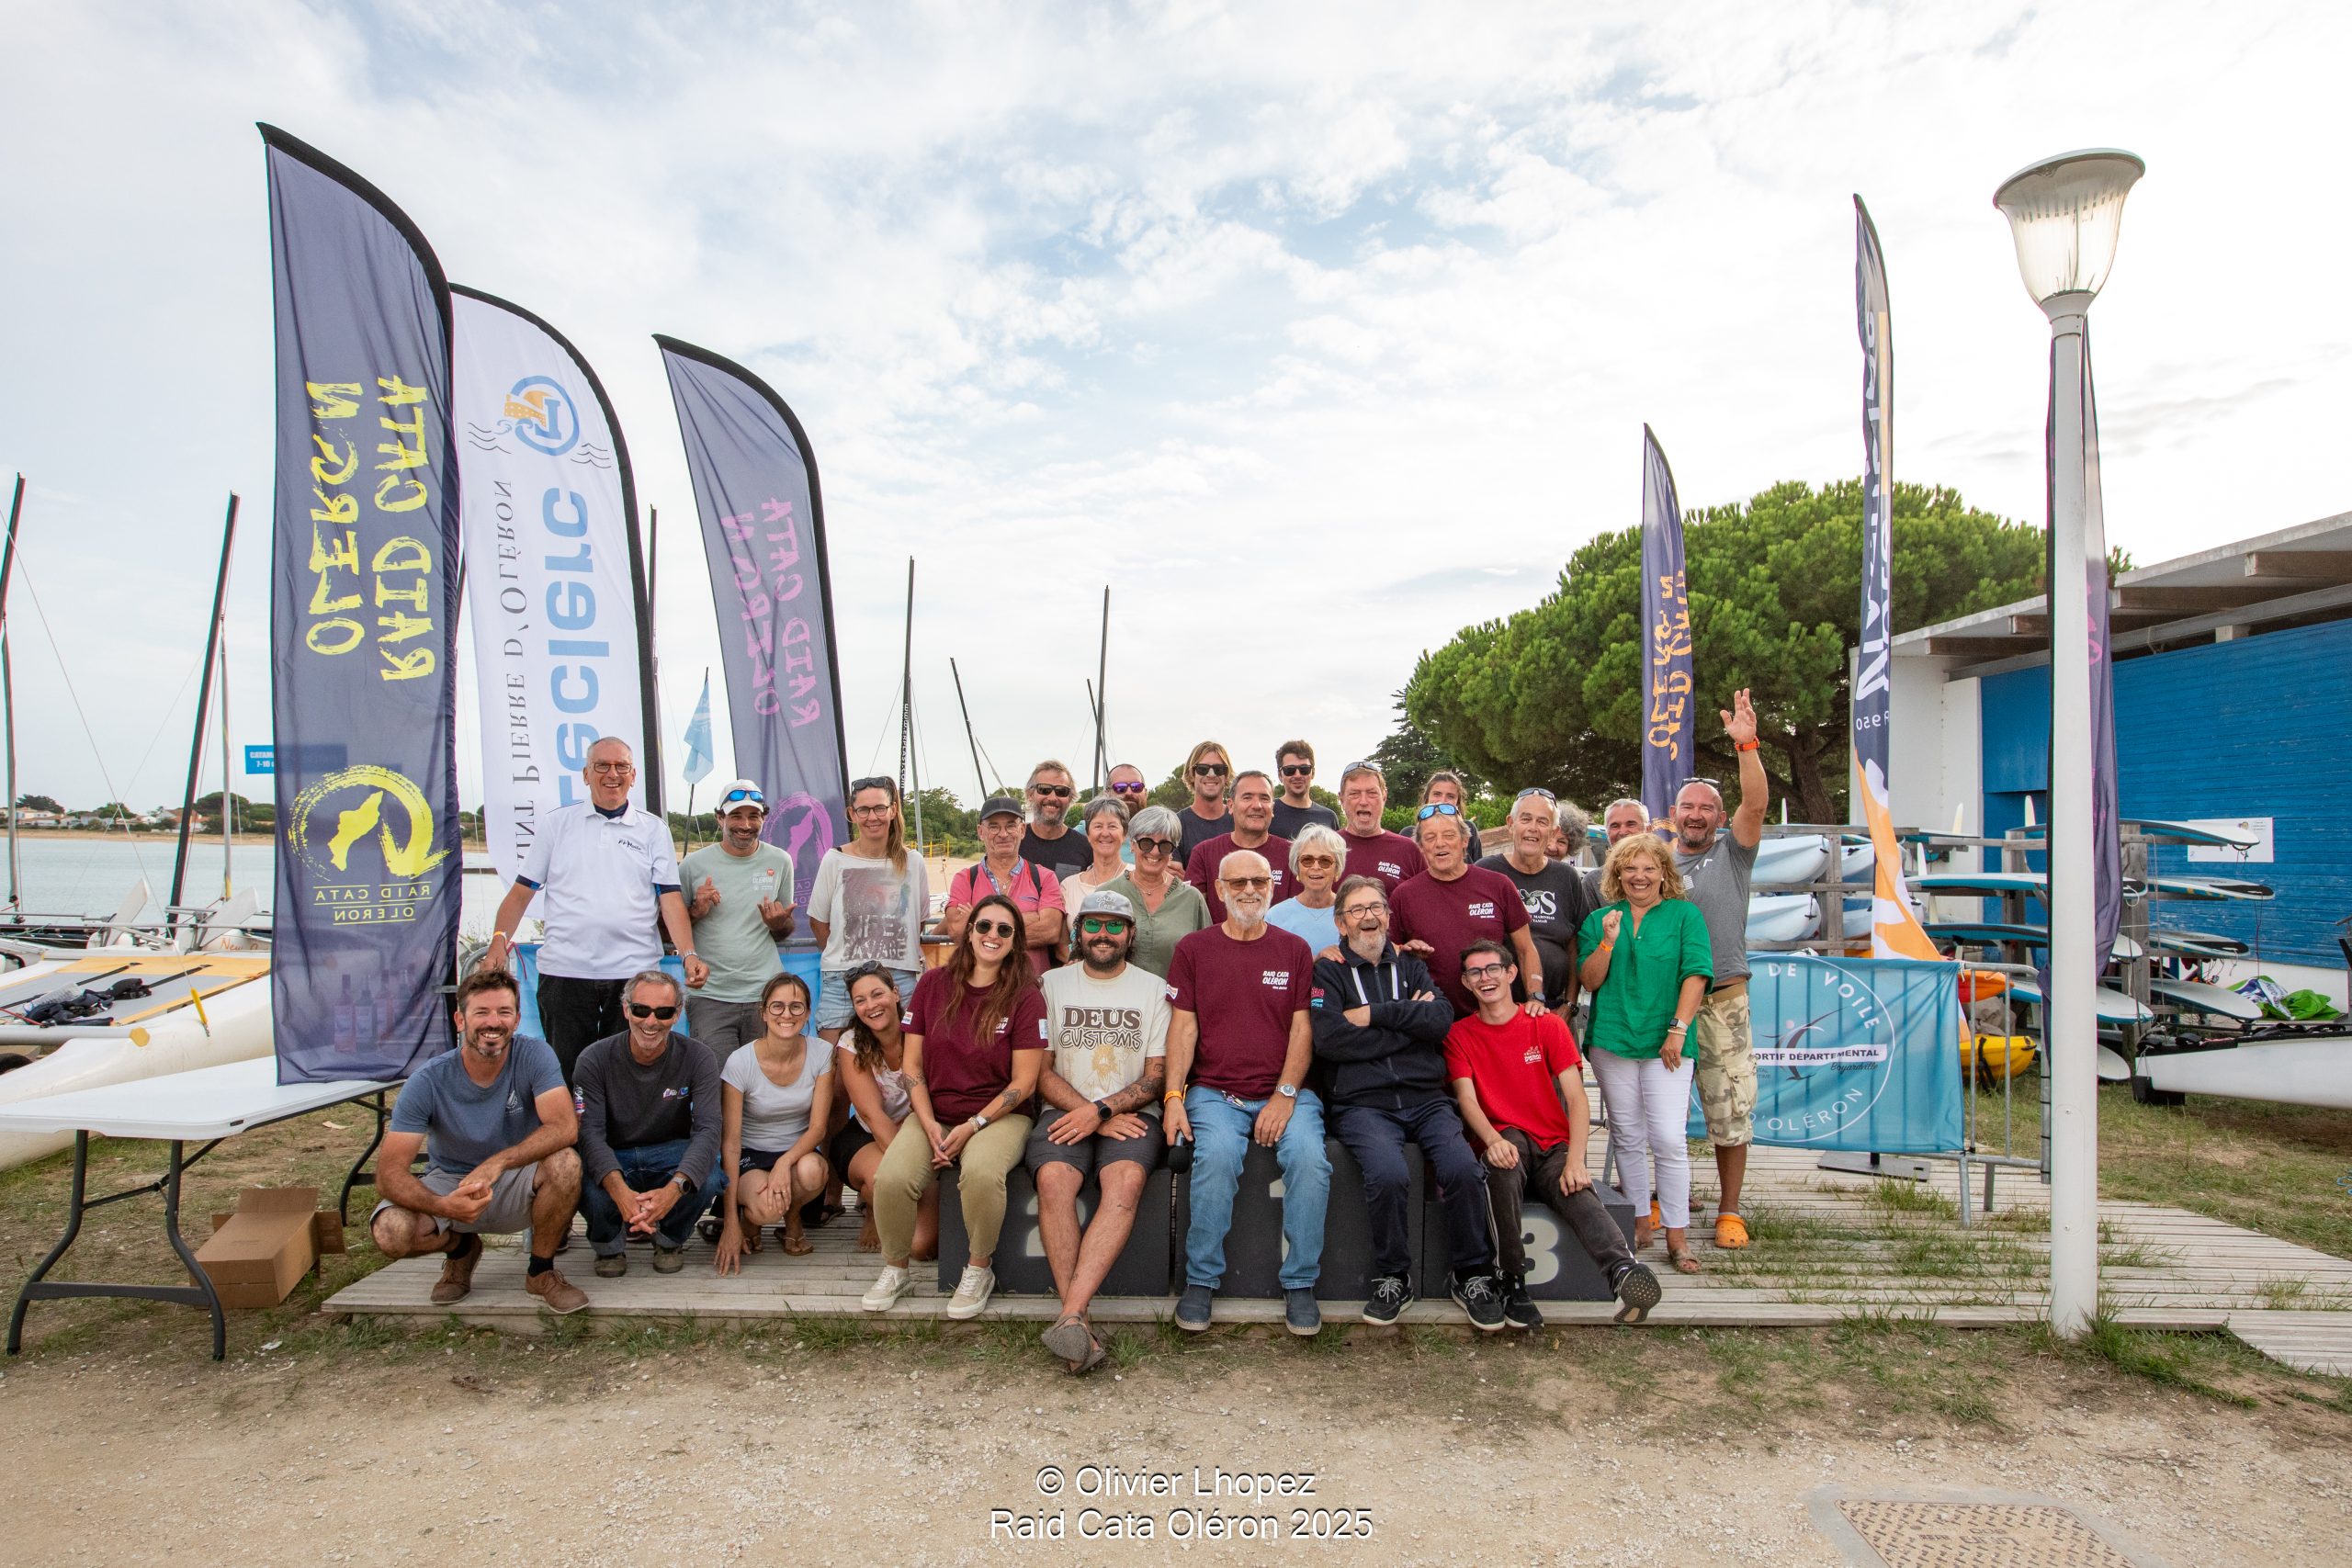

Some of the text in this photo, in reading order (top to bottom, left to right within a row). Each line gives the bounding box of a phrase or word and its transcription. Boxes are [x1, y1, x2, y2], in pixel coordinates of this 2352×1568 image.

[1768, 963, 1880, 1029] DE VOILE
[1062, 1006, 1142, 1031] DEUS
[1058, 1028, 1144, 1052] CUSTOMS
[1755, 1049, 1879, 1061] ORTIF DÉPARTEMENTAL
